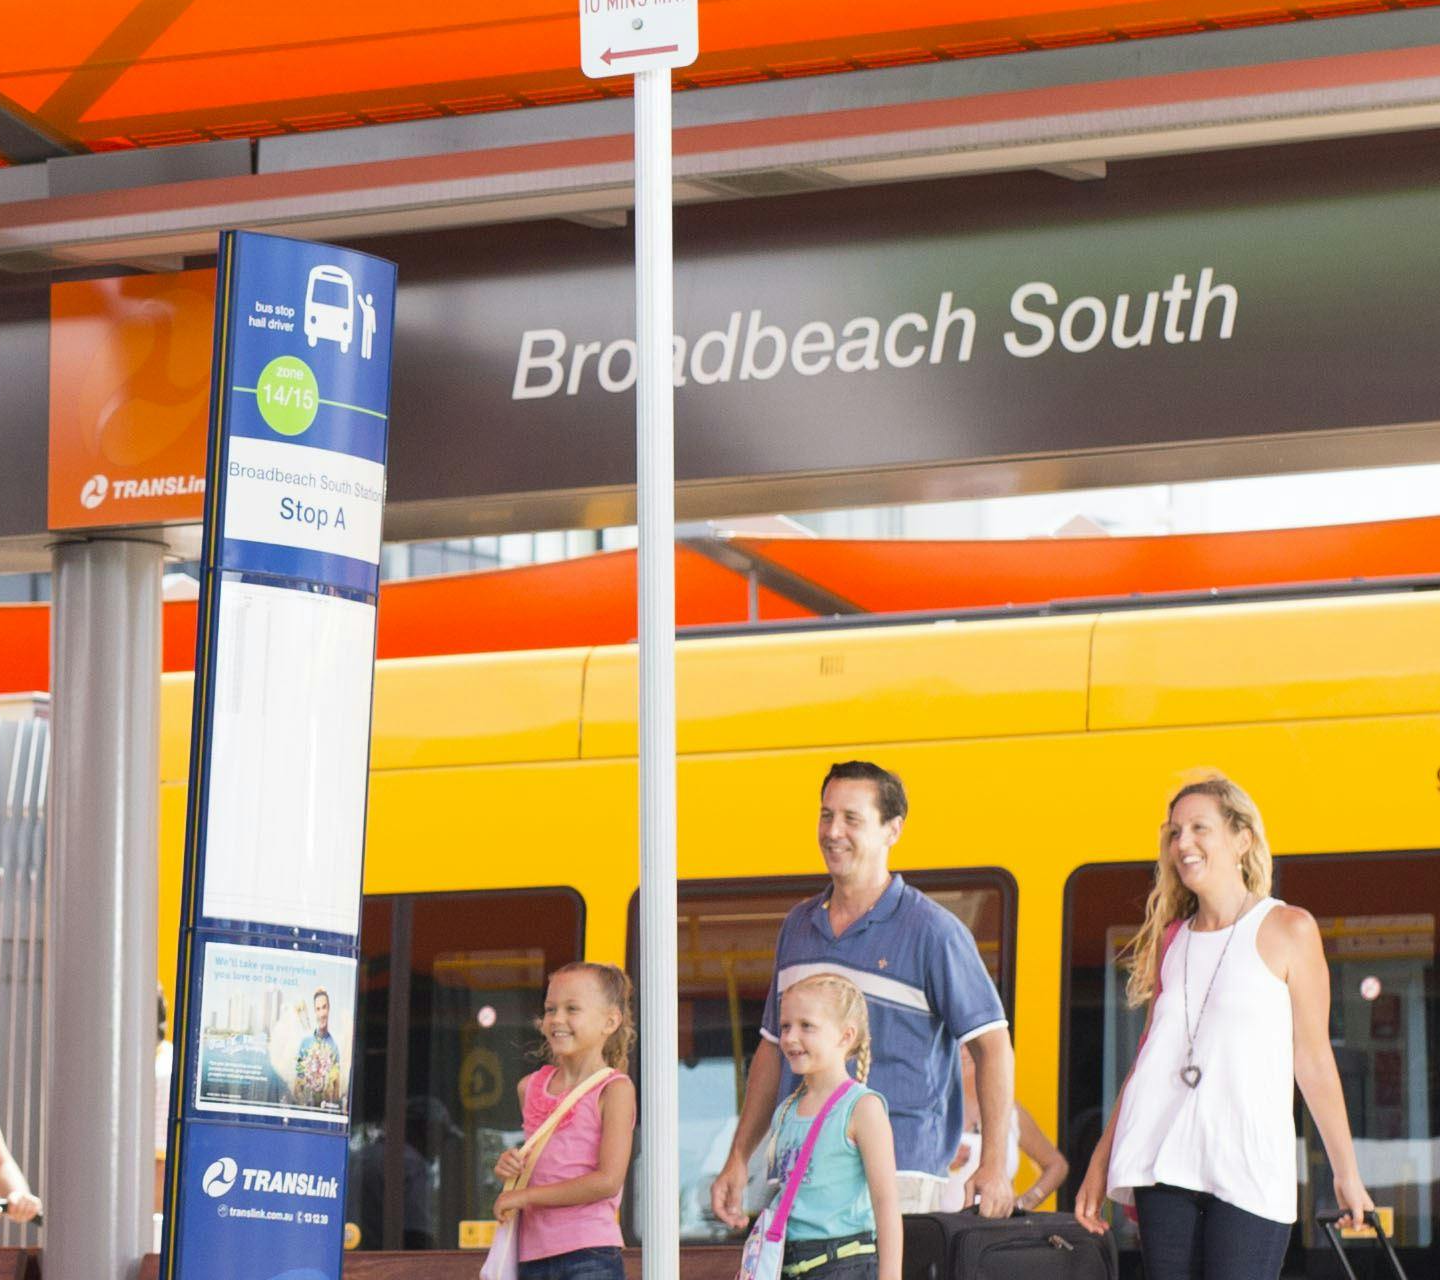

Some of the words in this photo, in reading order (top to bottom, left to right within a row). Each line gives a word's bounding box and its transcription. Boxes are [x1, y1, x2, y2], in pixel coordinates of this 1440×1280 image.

[255, 301, 273, 315] bus
[275, 303, 295, 318] stop
[1002, 266, 1240, 359] South
[248, 316, 267, 328] hail
[268, 319, 294, 333] driver
[276, 366, 304, 380] zone
[263, 383, 314, 410] 14/15
[112, 475, 206, 500] TRANSLin
[229, 461, 317, 489] Broadbeach
[320, 473, 352, 497] South
[354, 480, 383, 503] Station
[279, 496, 328, 530] Stop
[334, 506, 346, 530] A
[242, 1168, 339, 1199] TRANSLink
[229, 1206, 294, 1222] translink.com.au
